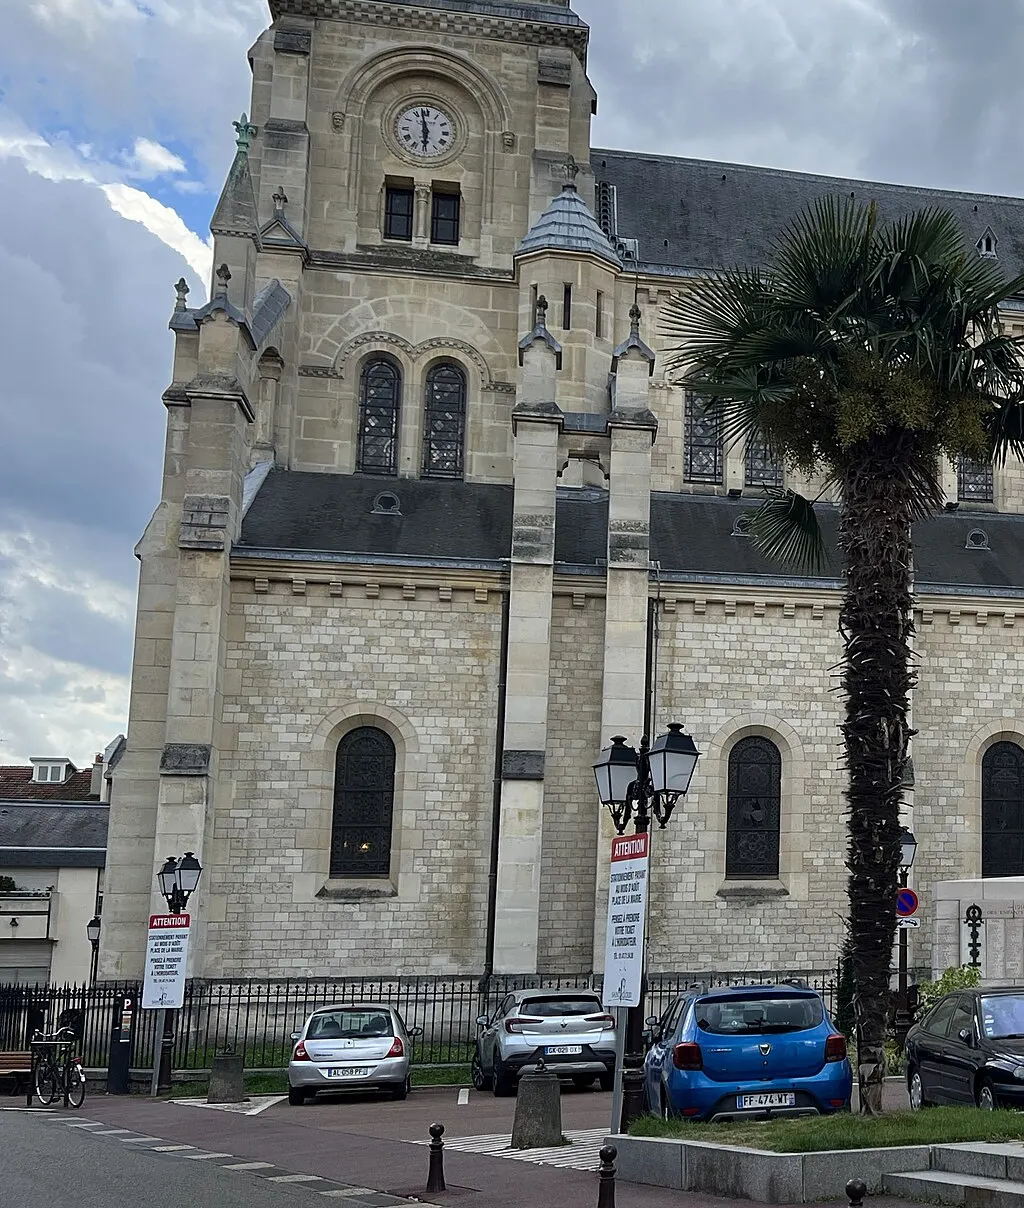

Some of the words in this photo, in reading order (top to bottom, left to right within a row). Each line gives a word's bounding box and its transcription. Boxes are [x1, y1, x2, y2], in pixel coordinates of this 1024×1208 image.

[614, 839, 645, 857] ATTENTION
[153, 917, 187, 927] ATTENTION
[124, 998, 131, 1009] P
